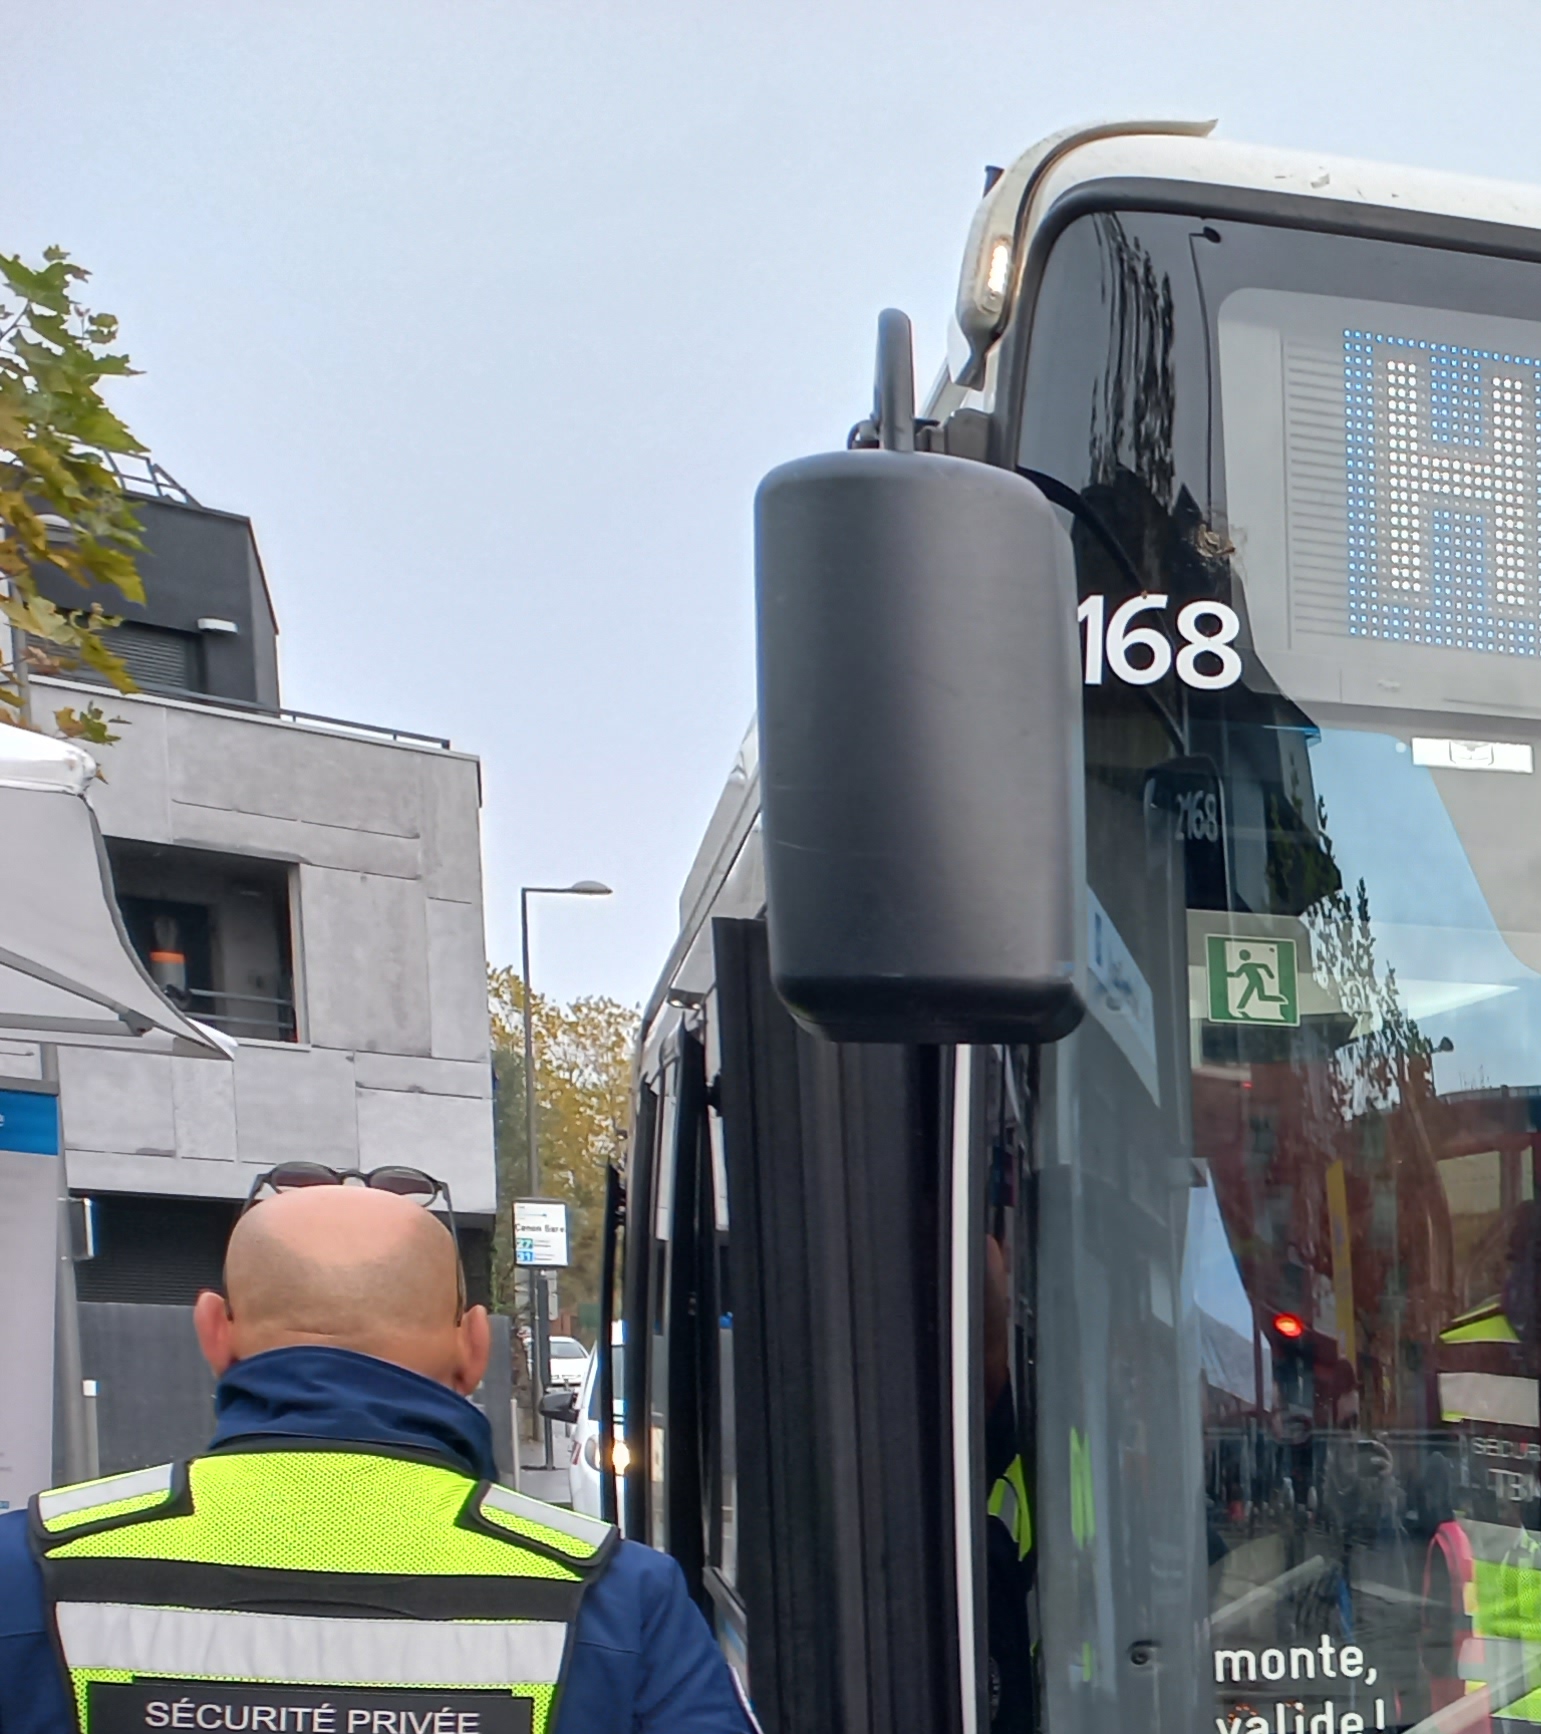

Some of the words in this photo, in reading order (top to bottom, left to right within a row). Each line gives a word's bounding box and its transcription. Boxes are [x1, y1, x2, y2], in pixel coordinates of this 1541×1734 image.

[1386, 359, 1525, 605] H
[1214, 1633, 1378, 1686] monte,
[144, 1697, 337, 1734] SÉCURITÉ
